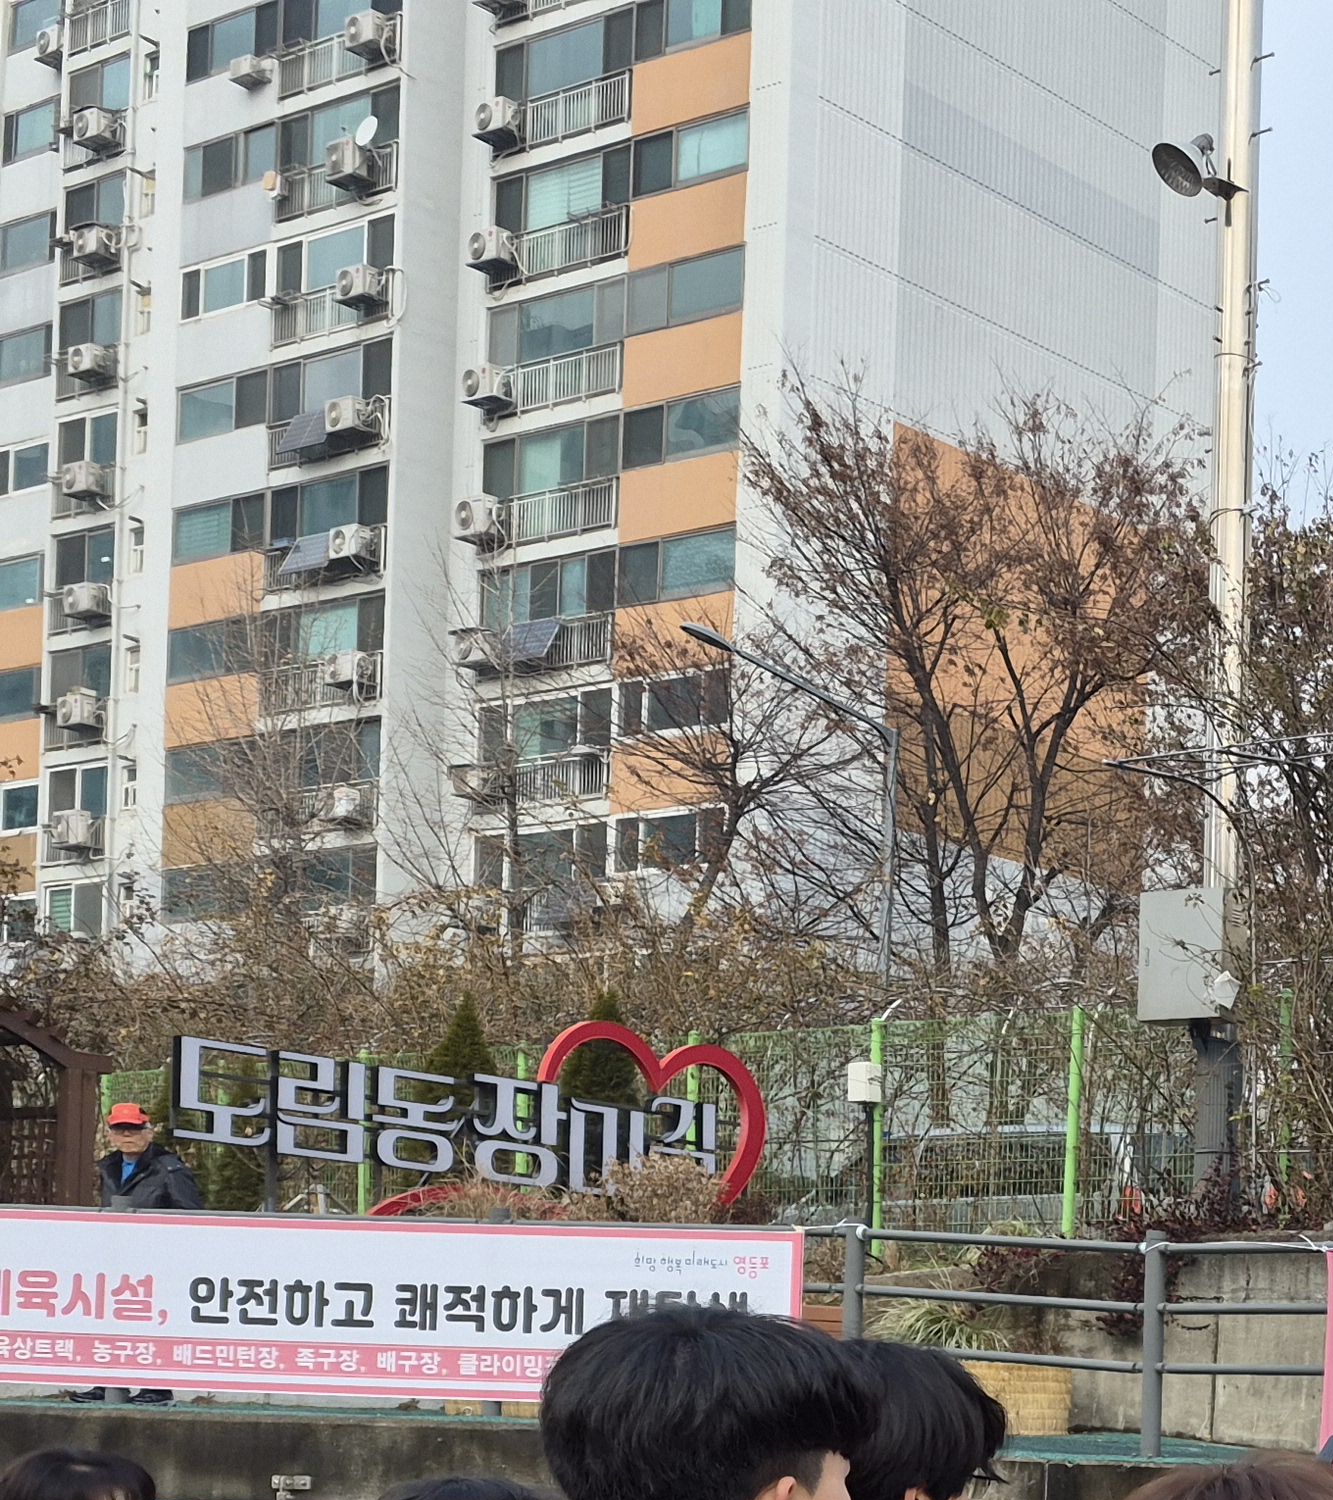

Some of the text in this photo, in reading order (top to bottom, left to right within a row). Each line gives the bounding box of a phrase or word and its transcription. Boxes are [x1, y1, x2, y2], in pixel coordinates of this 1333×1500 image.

[634, 1248, 769, 1279] 희망 행복 미래도시 영등포
[189, 1276, 375, 1329] 안전하고
[393, 1283, 585, 1335] 쾌적하게
[92, 1340, 162, 1365] 농구장,
[173, 1344, 284, 1371] 배드민턴장,
[294, 1347, 366, 1373] 족구장,
[377, 1351, 447, 1376] 배구장,
